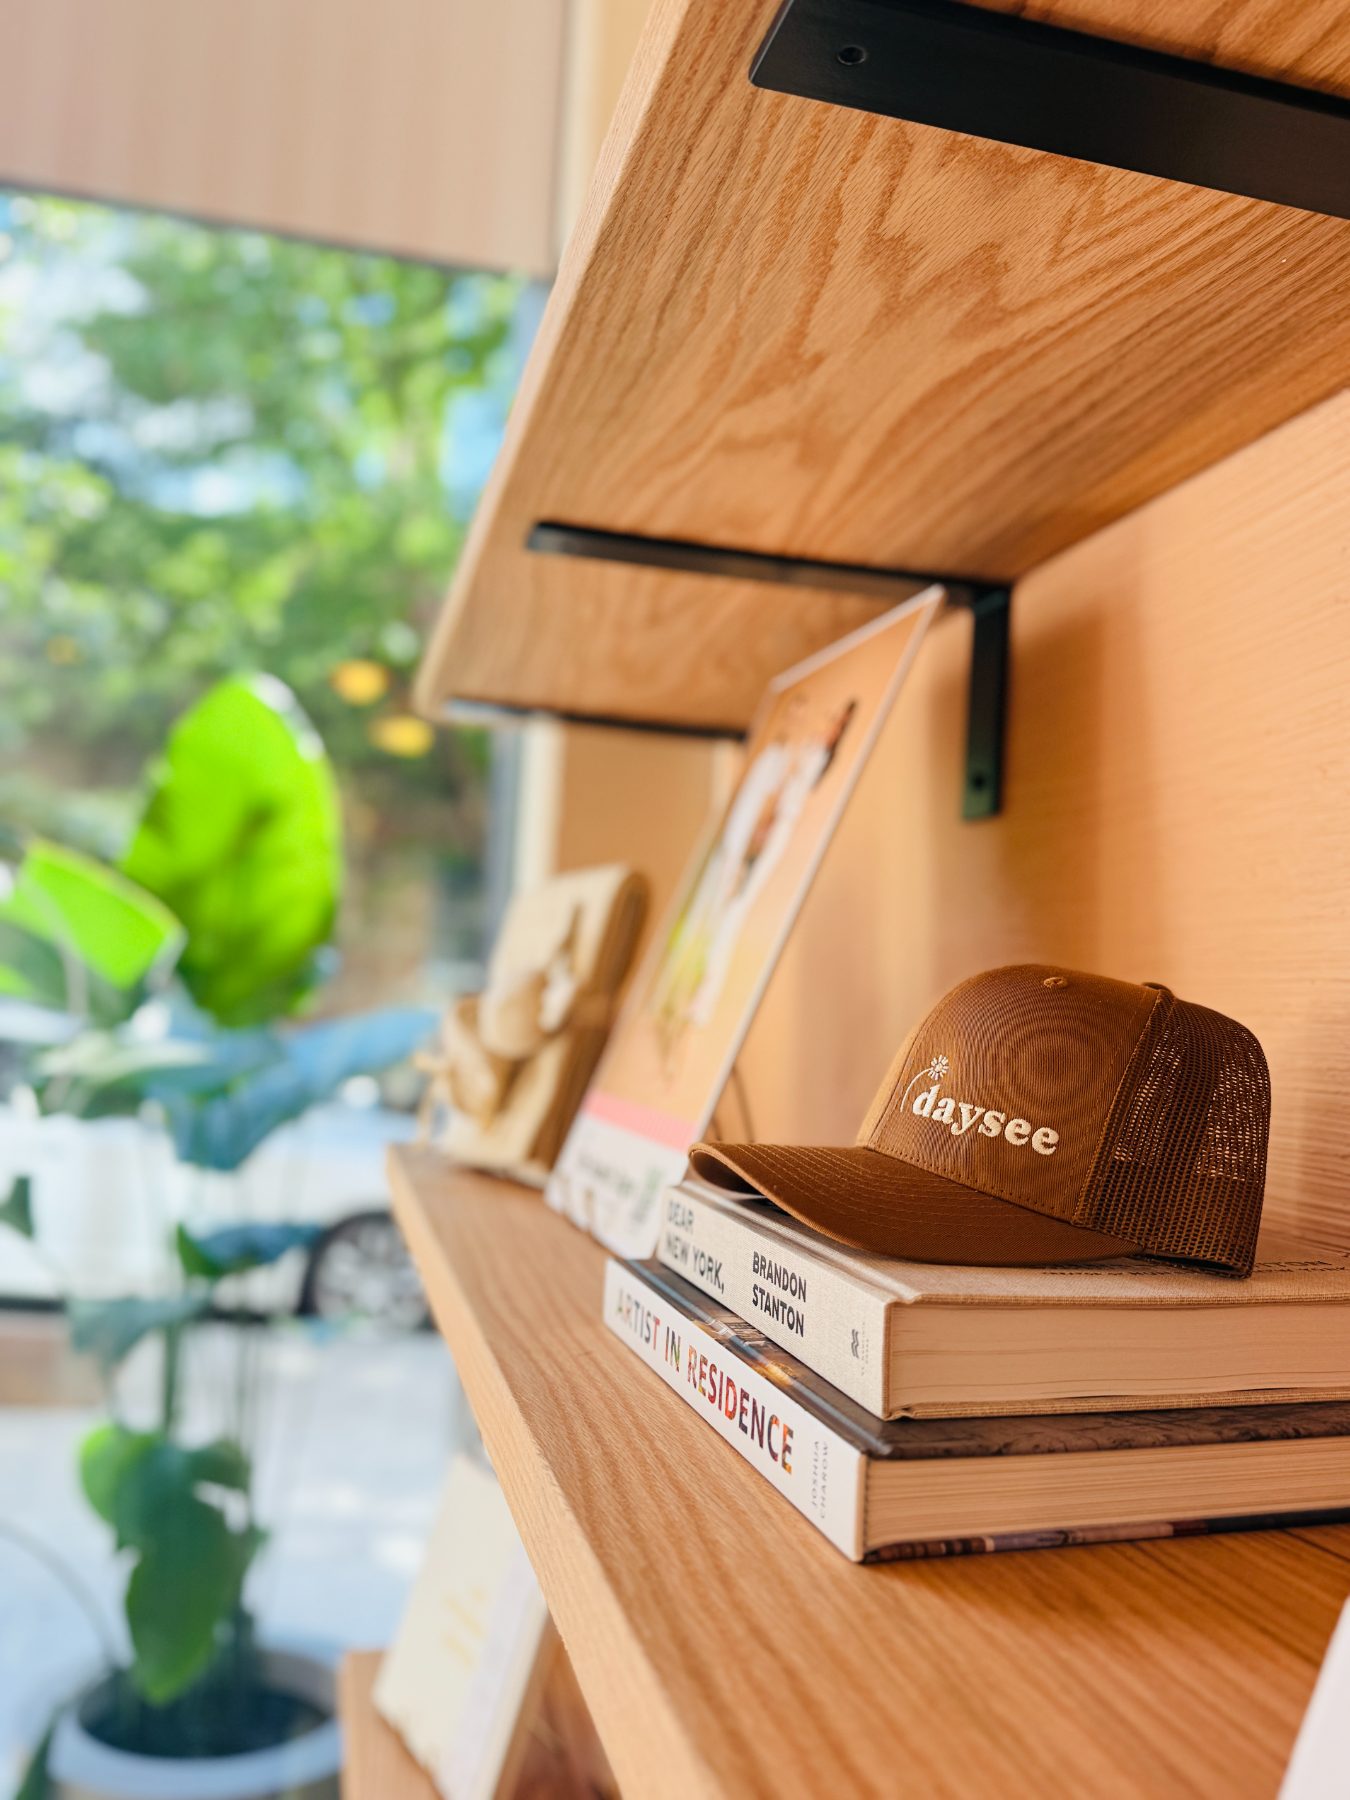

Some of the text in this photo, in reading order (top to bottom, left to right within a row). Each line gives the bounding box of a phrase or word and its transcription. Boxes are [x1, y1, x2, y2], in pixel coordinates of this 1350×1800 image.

[912, 1084, 1060, 1156] daysee
[667, 1199, 695, 1234] DEAR
[665, 1231, 725, 1295] NEW YORK,
[753, 1250, 807, 1303] BRANDON
[752, 1283, 805, 1338] STANTON
[615, 1287, 661, 1350] ARTIST
[664, 1325, 681, 1373] IN
[687, 1344, 794, 1474] RESIDENCE
